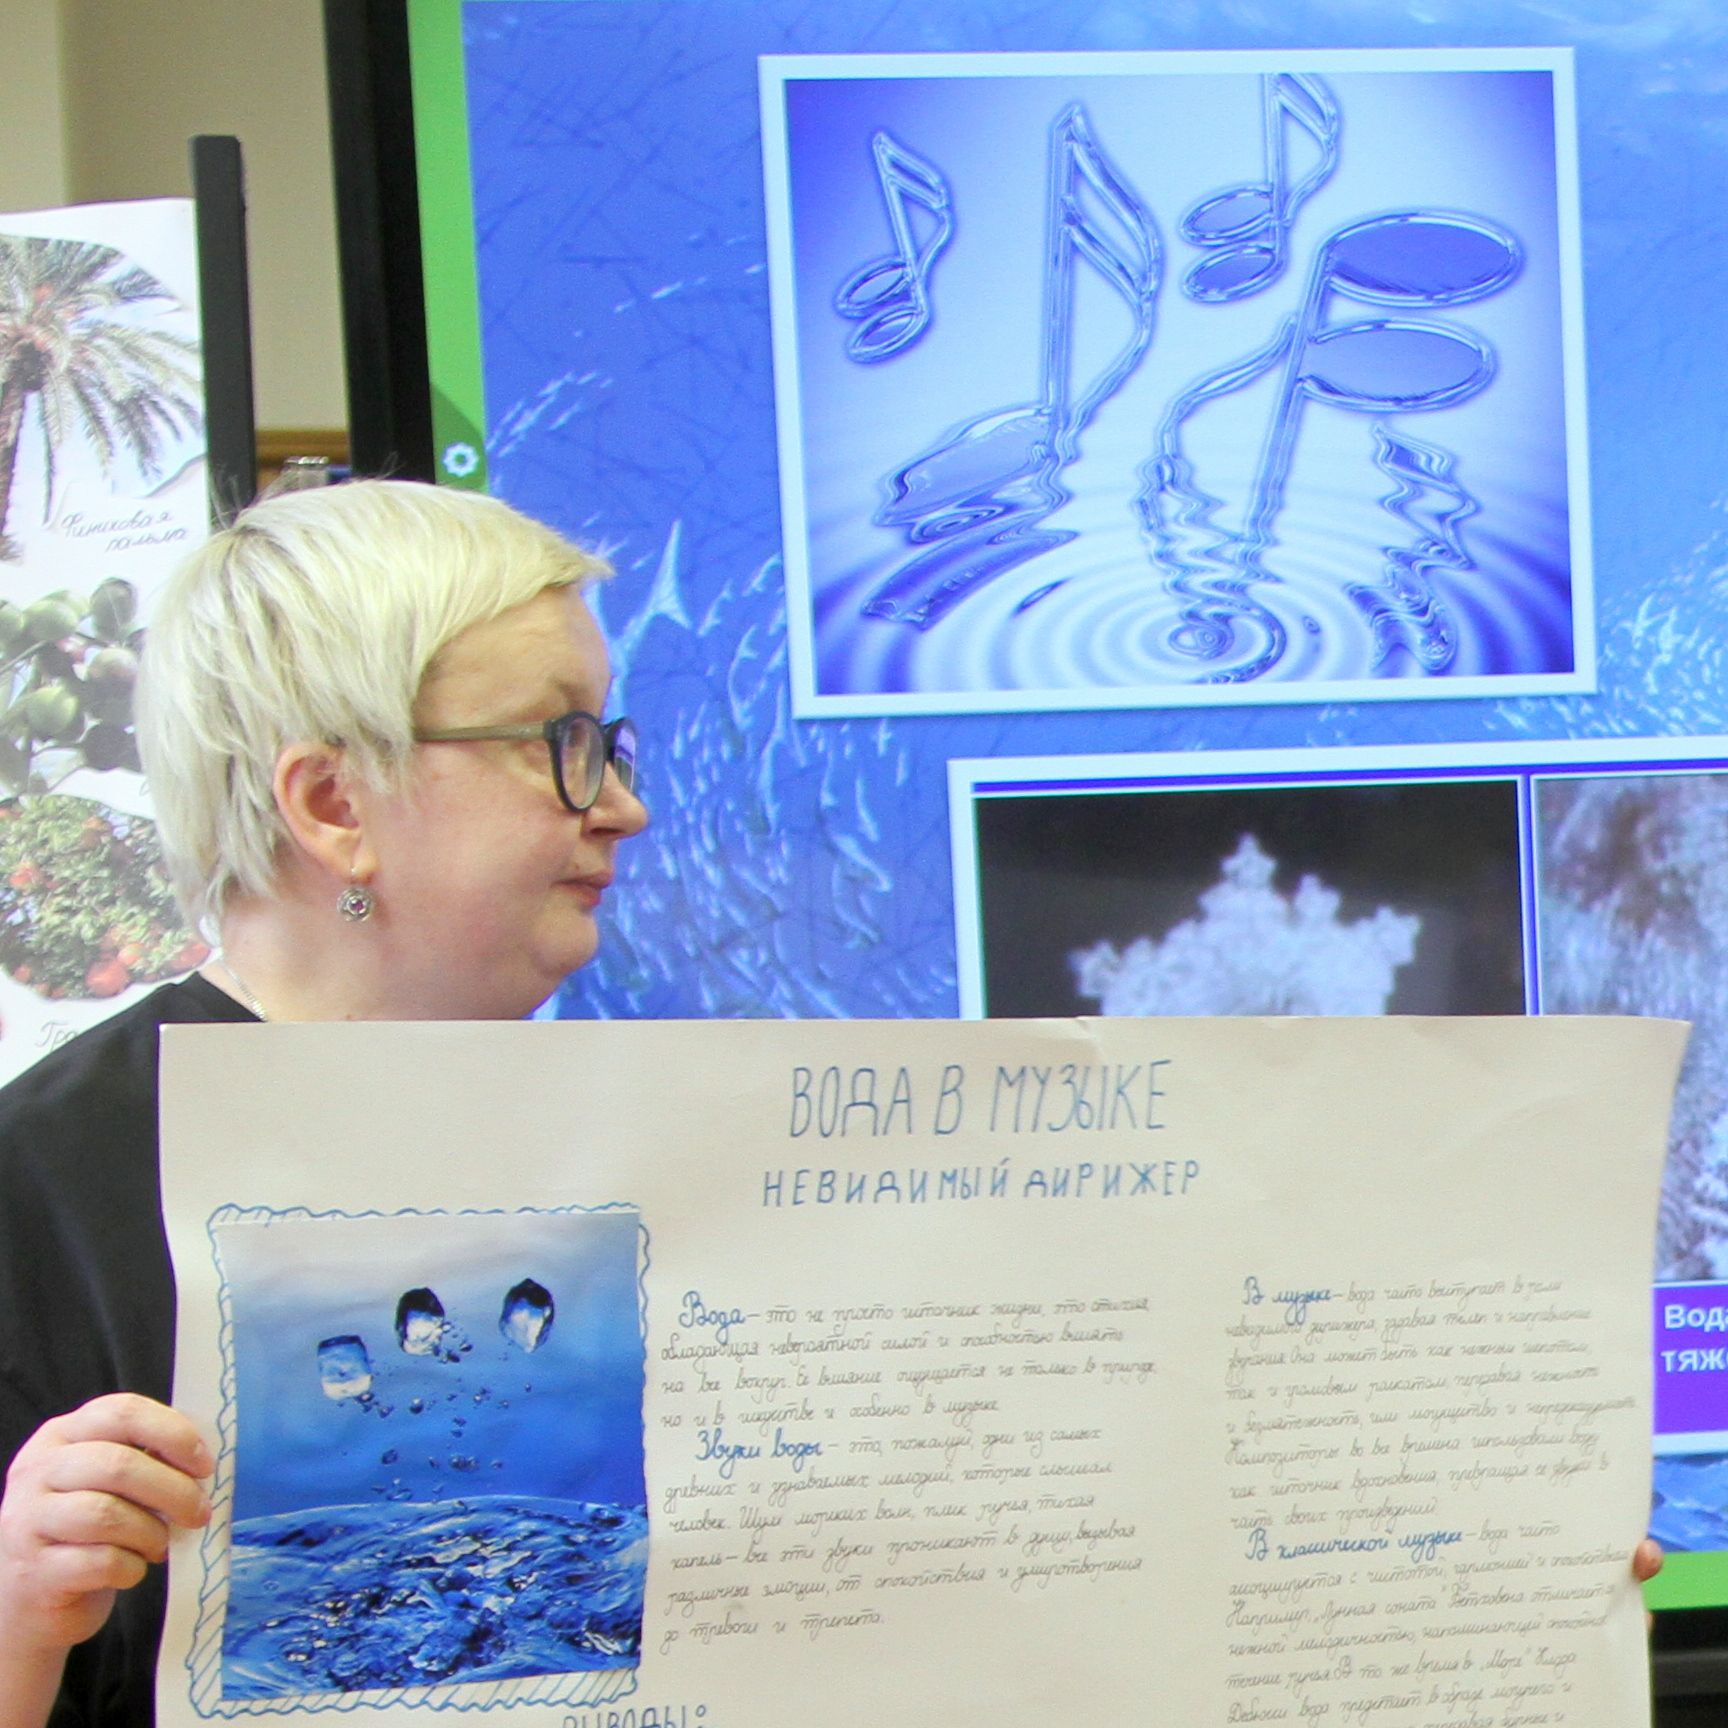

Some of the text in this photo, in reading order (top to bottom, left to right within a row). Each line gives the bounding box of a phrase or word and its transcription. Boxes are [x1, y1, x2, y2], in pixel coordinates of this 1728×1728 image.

[789, 1060, 1172, 1138] ВОДА В МУЗЫКЕ
[762, 1158, 1200, 1207] НЕВИДИМЫЙ ДИРИЖЕР
[1242, 1276, 1265, 1305] В
[696, 1430, 761, 1479] Звуки
[771, 1426, 823, 1472] воды
[738, 1506, 782, 1542] Шум
[1244, 1526, 1463, 1564] В классической музыке
